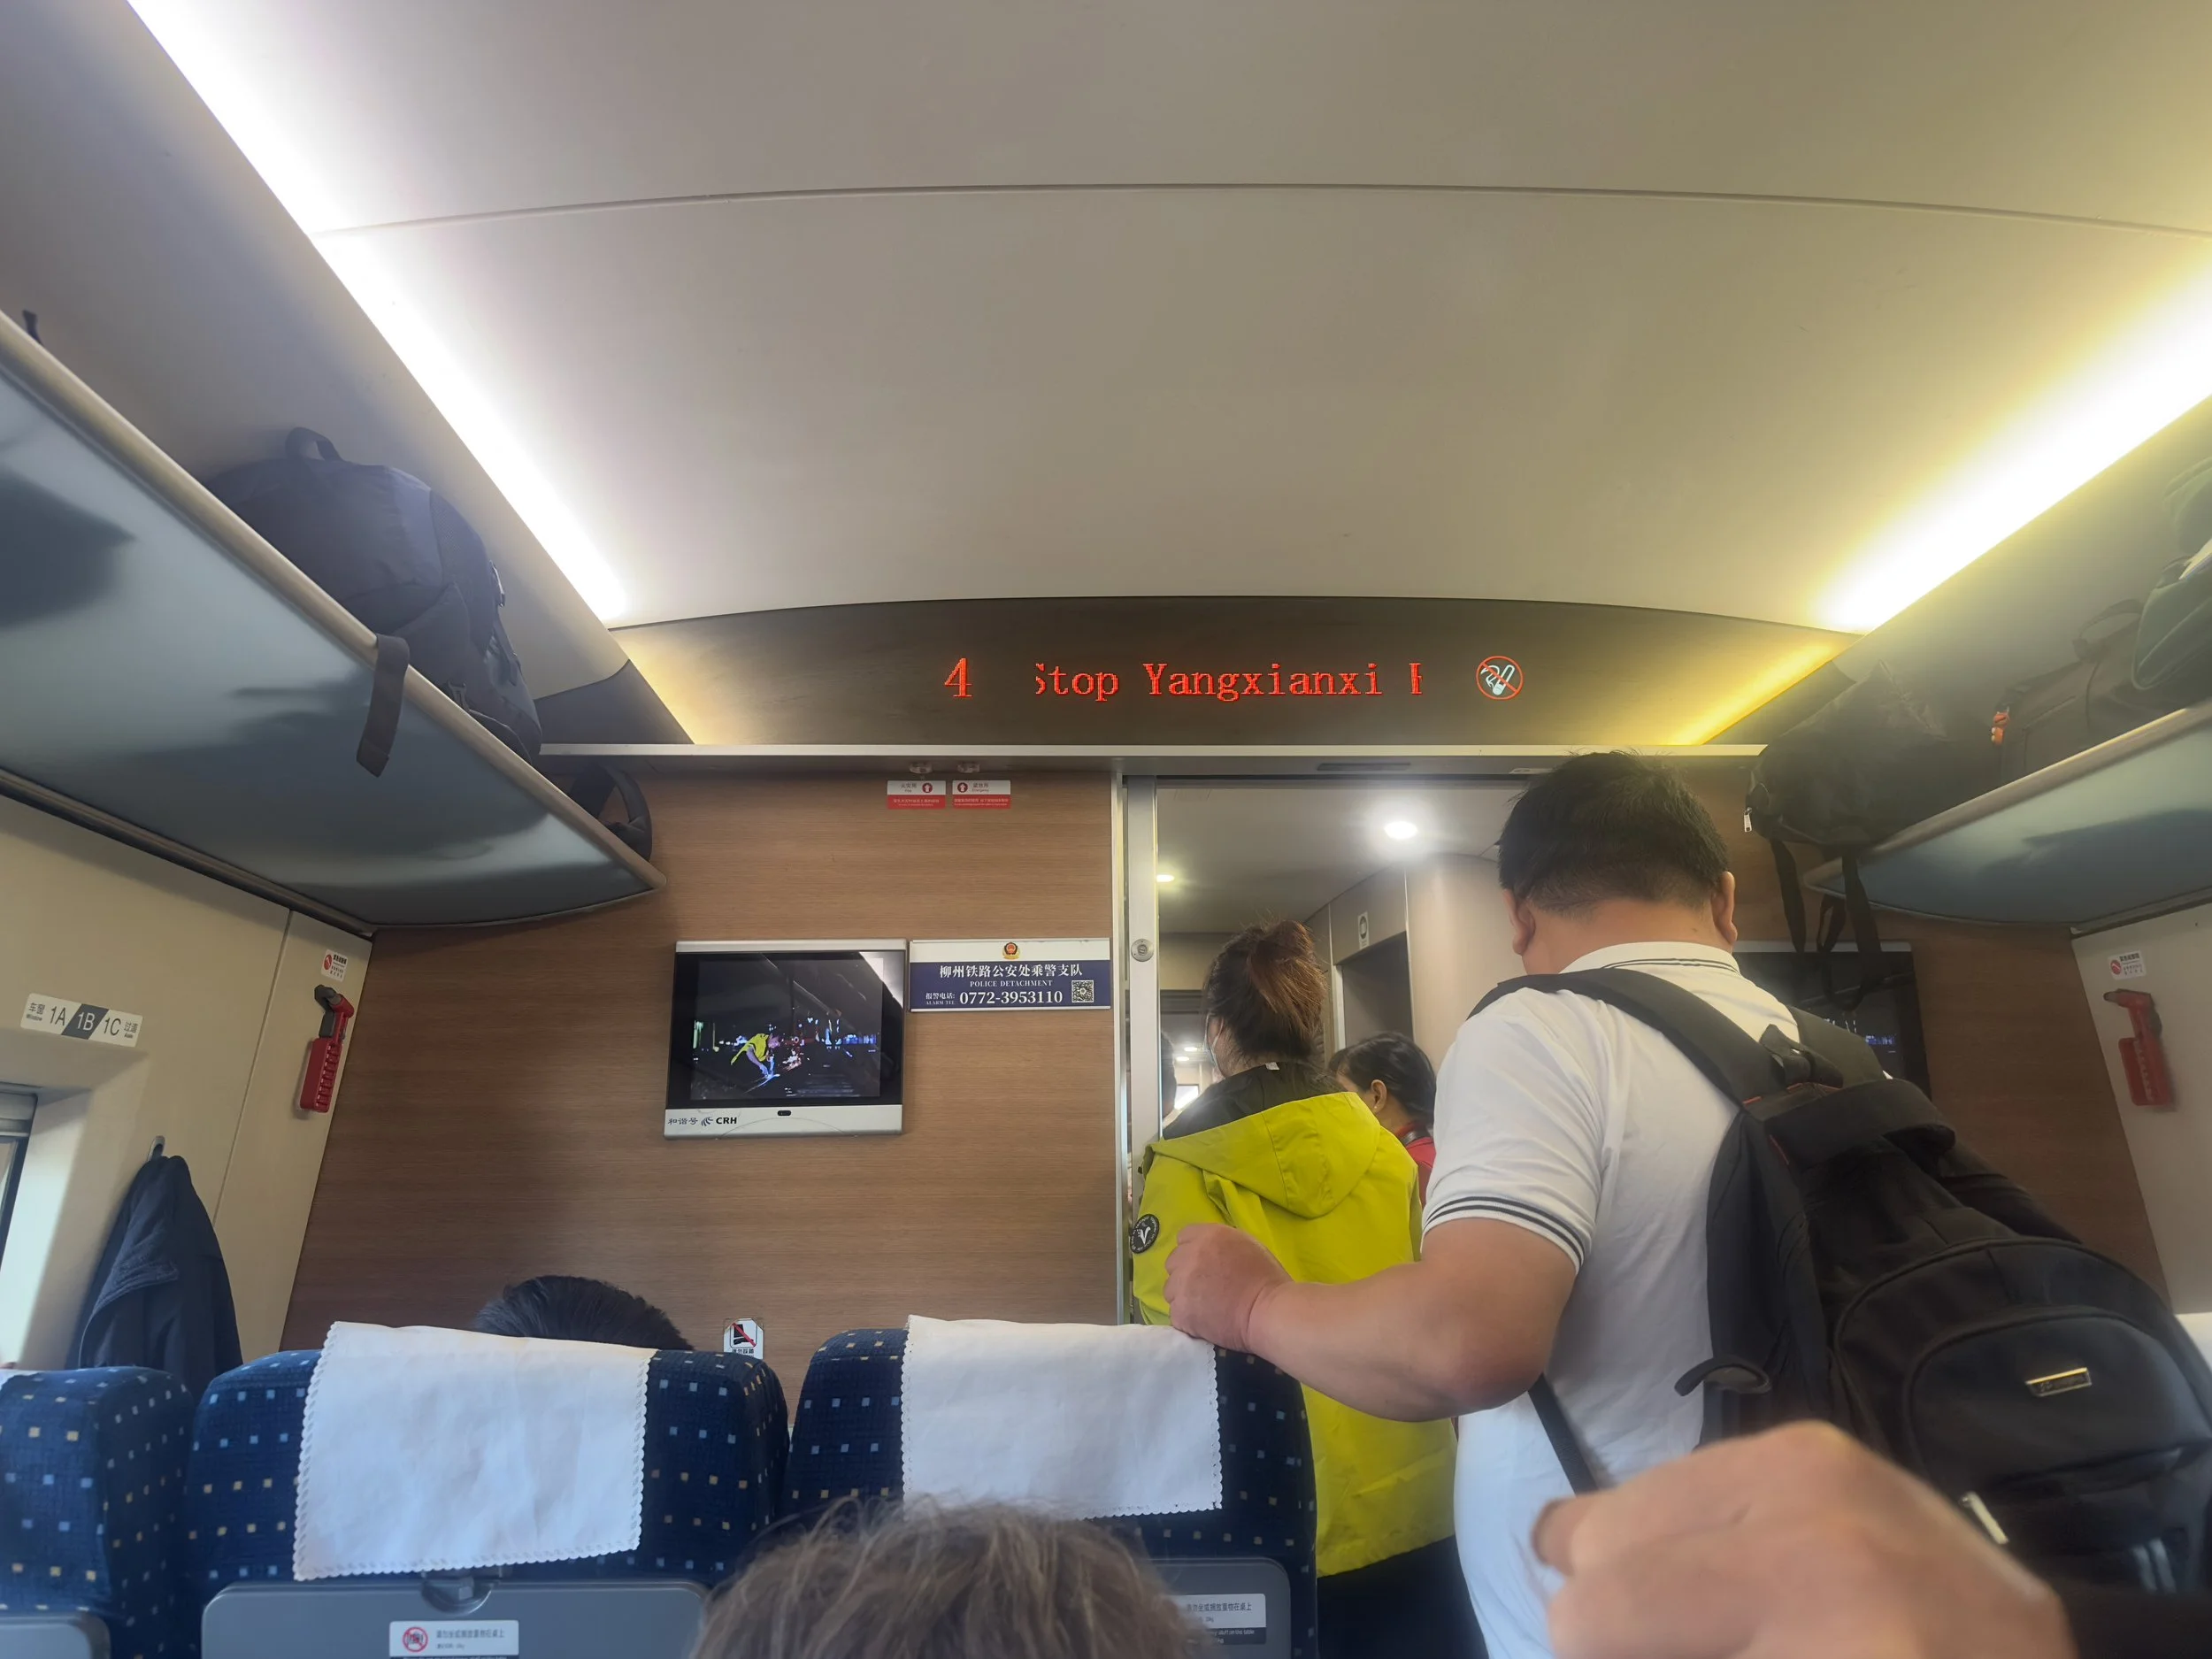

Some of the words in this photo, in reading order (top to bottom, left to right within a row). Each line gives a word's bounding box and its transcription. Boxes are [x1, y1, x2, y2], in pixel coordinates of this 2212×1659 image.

[944, 657, 972, 697] 4
[1142, 663, 1382, 701] Yangxianxi
[940, 964, 1083, 979] 柳州铁路公安处乘警支队
[959, 990, 1063, 1004] 0772-3953110
[50, 1006, 66, 1026] 1A
[77, 1012, 96, 1031] 1B
[104, 1018, 122, 1036] 1C
